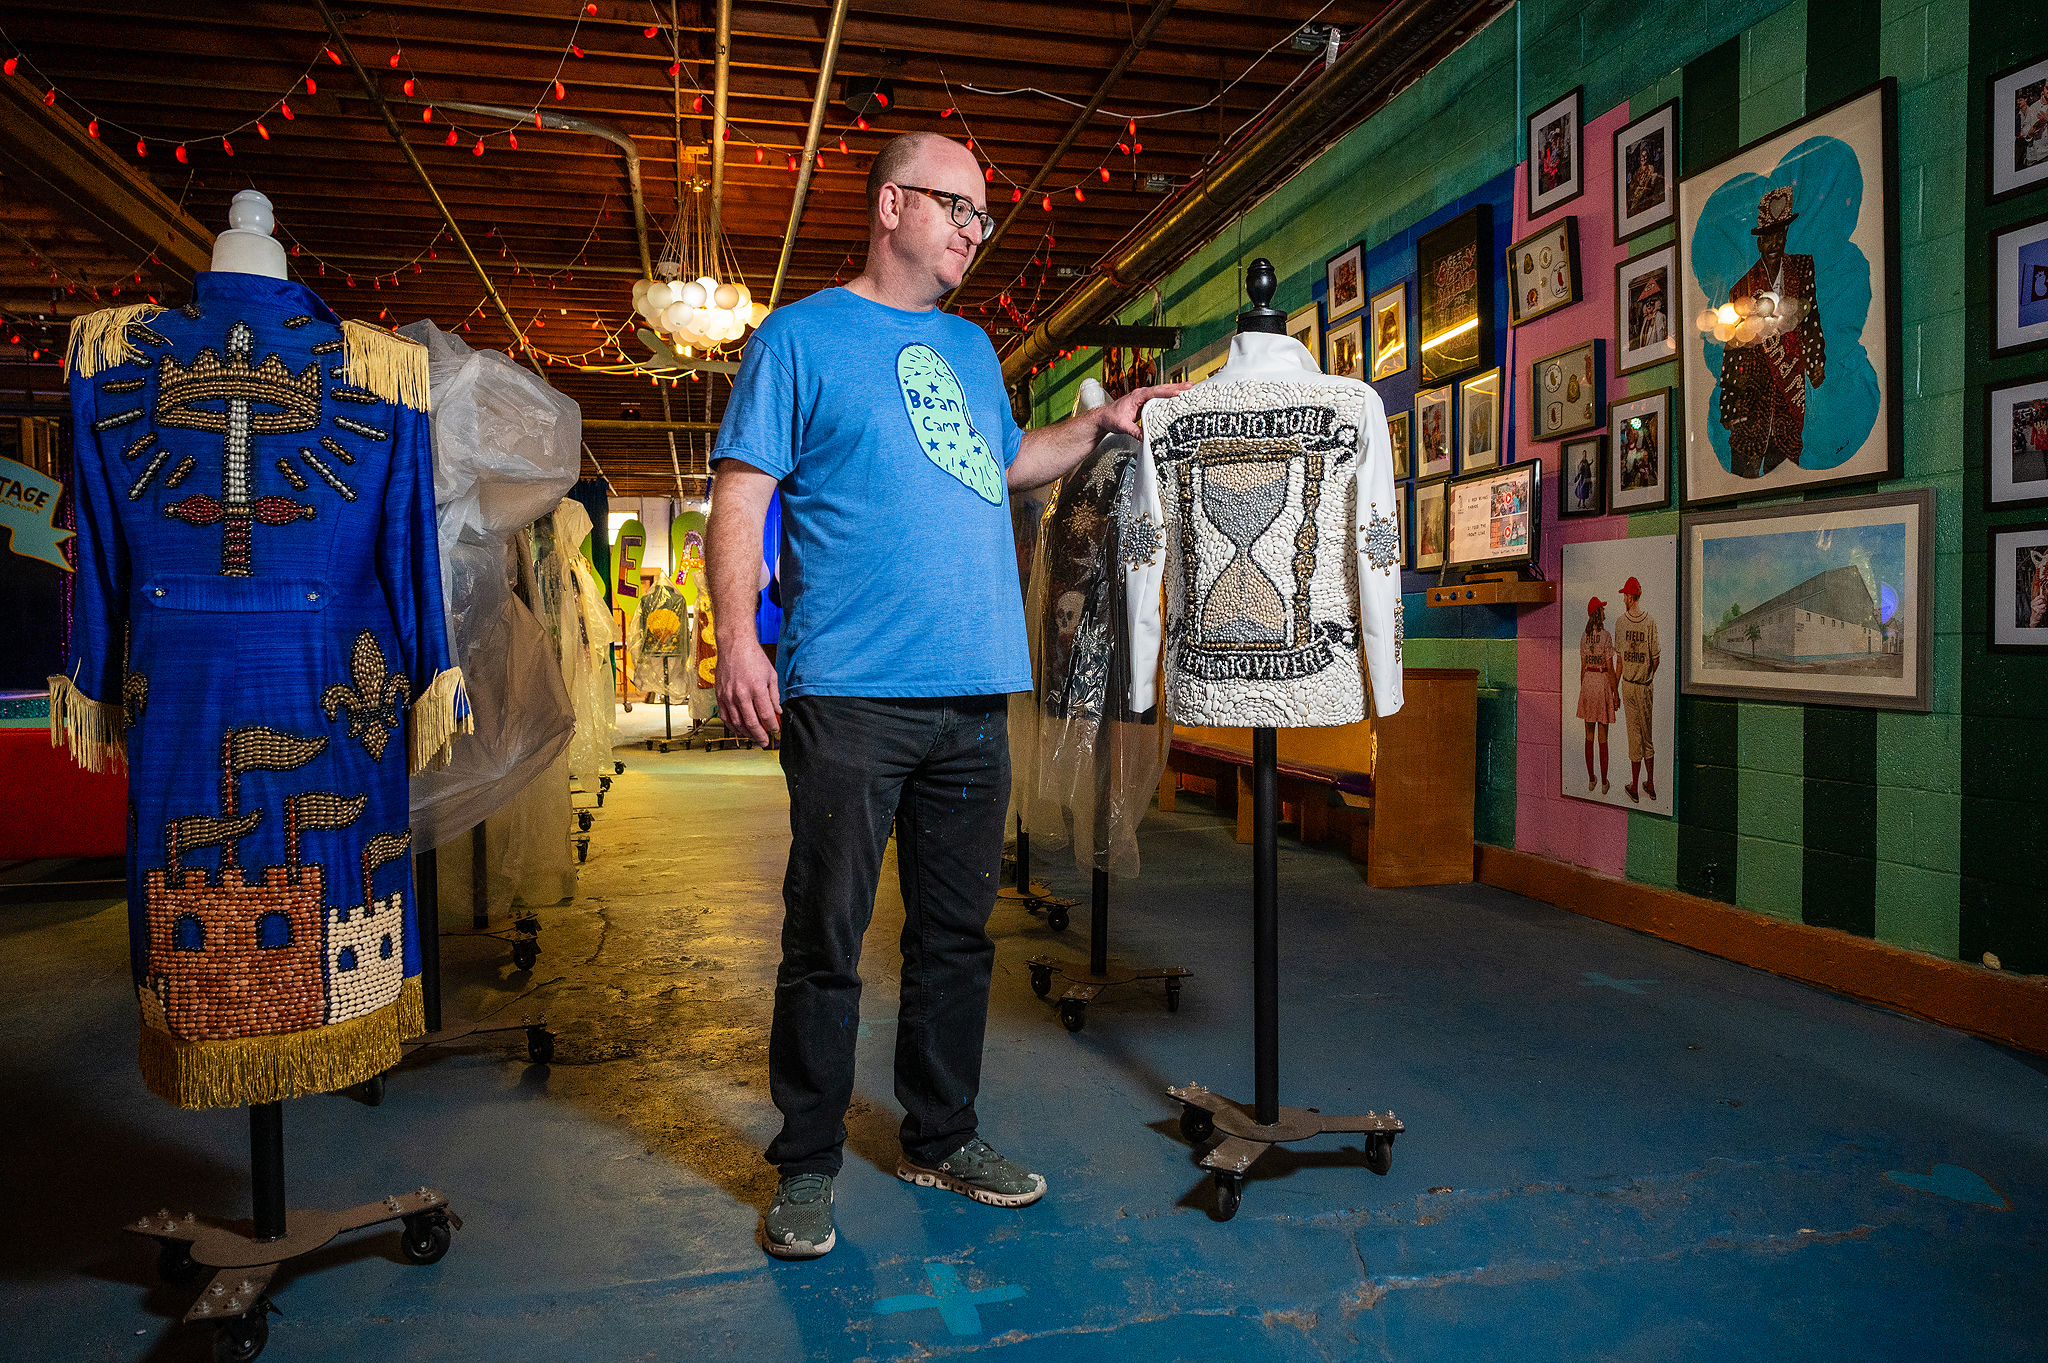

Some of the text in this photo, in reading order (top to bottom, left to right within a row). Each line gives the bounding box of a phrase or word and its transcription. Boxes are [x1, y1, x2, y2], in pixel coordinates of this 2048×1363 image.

[906, 388, 960, 412] Bean
[922, 415, 960, 436] Camp
[1177, 408, 1323, 441] MEMENTO MORI
[1626, 630, 1645, 642] FIELD
[1254, 644, 1332, 678] VIVERE
[1624, 651, 1645, 663] BEANS
